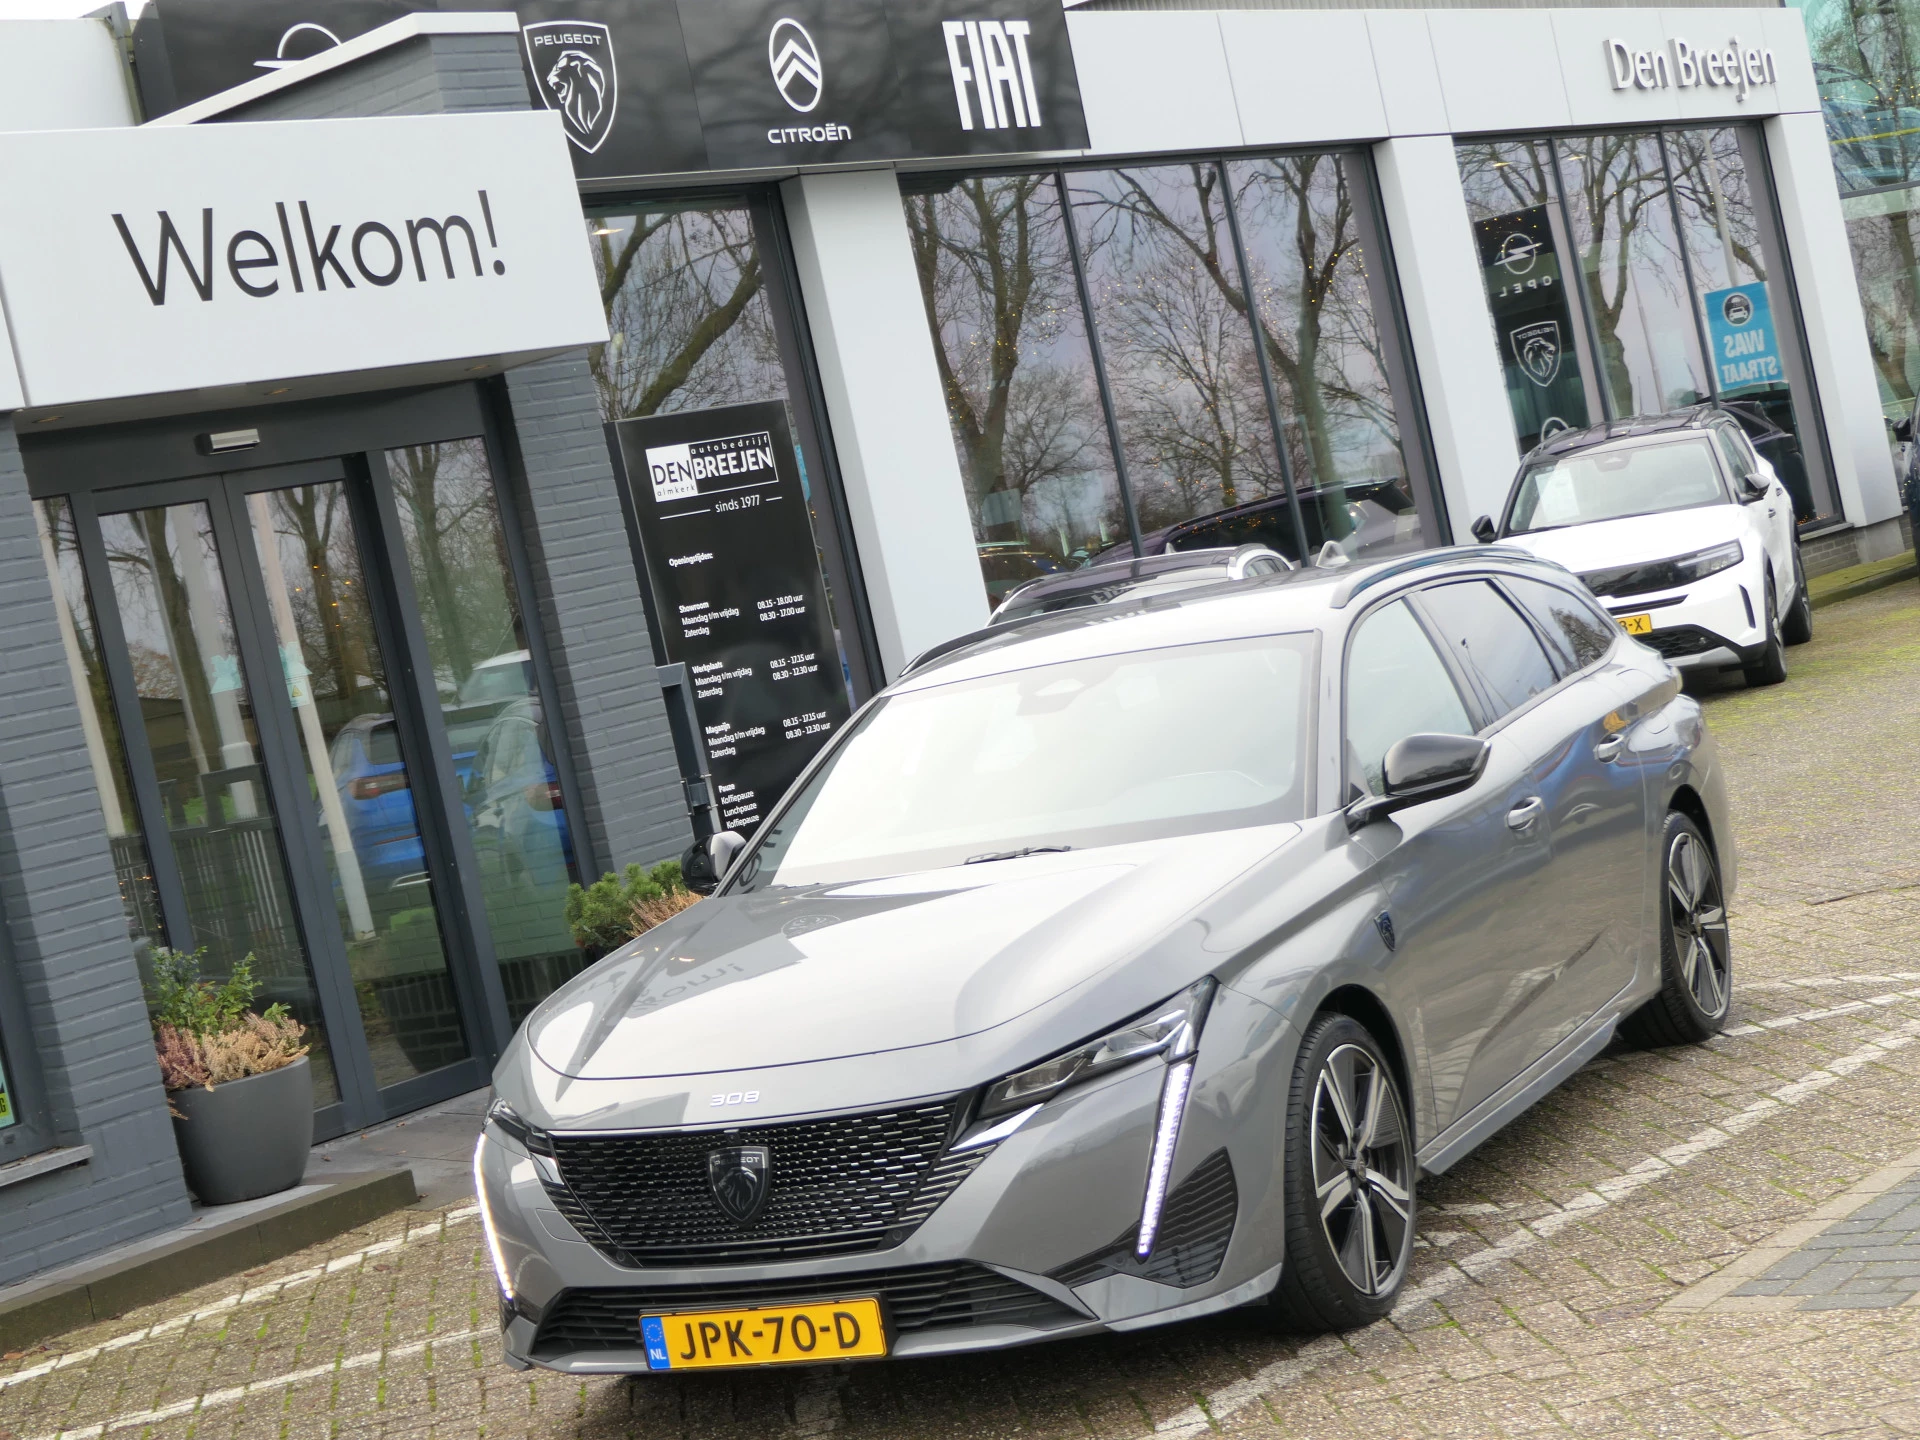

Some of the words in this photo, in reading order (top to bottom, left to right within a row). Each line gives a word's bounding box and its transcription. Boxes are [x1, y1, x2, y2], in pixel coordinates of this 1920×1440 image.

[534, 33, 602, 47] PEUGEOT
[942, 20, 1042, 131] FIAT
[1603, 37, 1672, 91] Den
[1668, 35, 1778, 103] Breejen
[111, 189, 506, 306] Welkom!
[690, 434, 769, 455] autobedrijf
[652, 459, 693, 486] DEN
[692, 446, 774, 480] BREEJEN
[656, 483, 696, 497] almkerk
[715, 499, 739, 513] sinds
[740, 494, 760, 509] 1977
[678, 601, 710, 614] Showroom
[681, 614, 709, 626] Maandag
[708, 611, 720, 621] t/m
[719, 607, 740, 618] vrijdag
[757, 599, 773, 610] 08.15
[792, 594, 803, 602] uur
[684, 626, 710, 638] Zaterdag
[795, 606, 806, 614] uur
[691, 661, 724, 674] Werkplaats
[694, 674, 722, 686] Maandag
[721, 671, 733, 680] t/m
[732, 667, 753, 678] vrijdag
[804, 652, 815, 661] uur
[697, 686, 723, 699] Zaterdag
[807, 664, 818, 673] uur
[705, 721, 731, 735] Magazijn
[708, 734, 735, 746] Maandag
[734, 731, 746, 740] t/m
[745, 726, 766, 738] vrijdag
[816, 711, 826, 719] uur
[710, 746, 737, 759] Zaterdag
[820, 722, 831, 731] uur
[717, 783, 736, 794] Pauze
[720, 790, 755, 805] Koffiepauze
[723, 802, 758, 817] Lunchpauze
[726, 814, 760, 829] Koffiepauze
[709, 1090, 760, 1107] 308
[680, 1311, 862, 1361] JPK-70-D
[650, 1348, 667, 1361] NL
